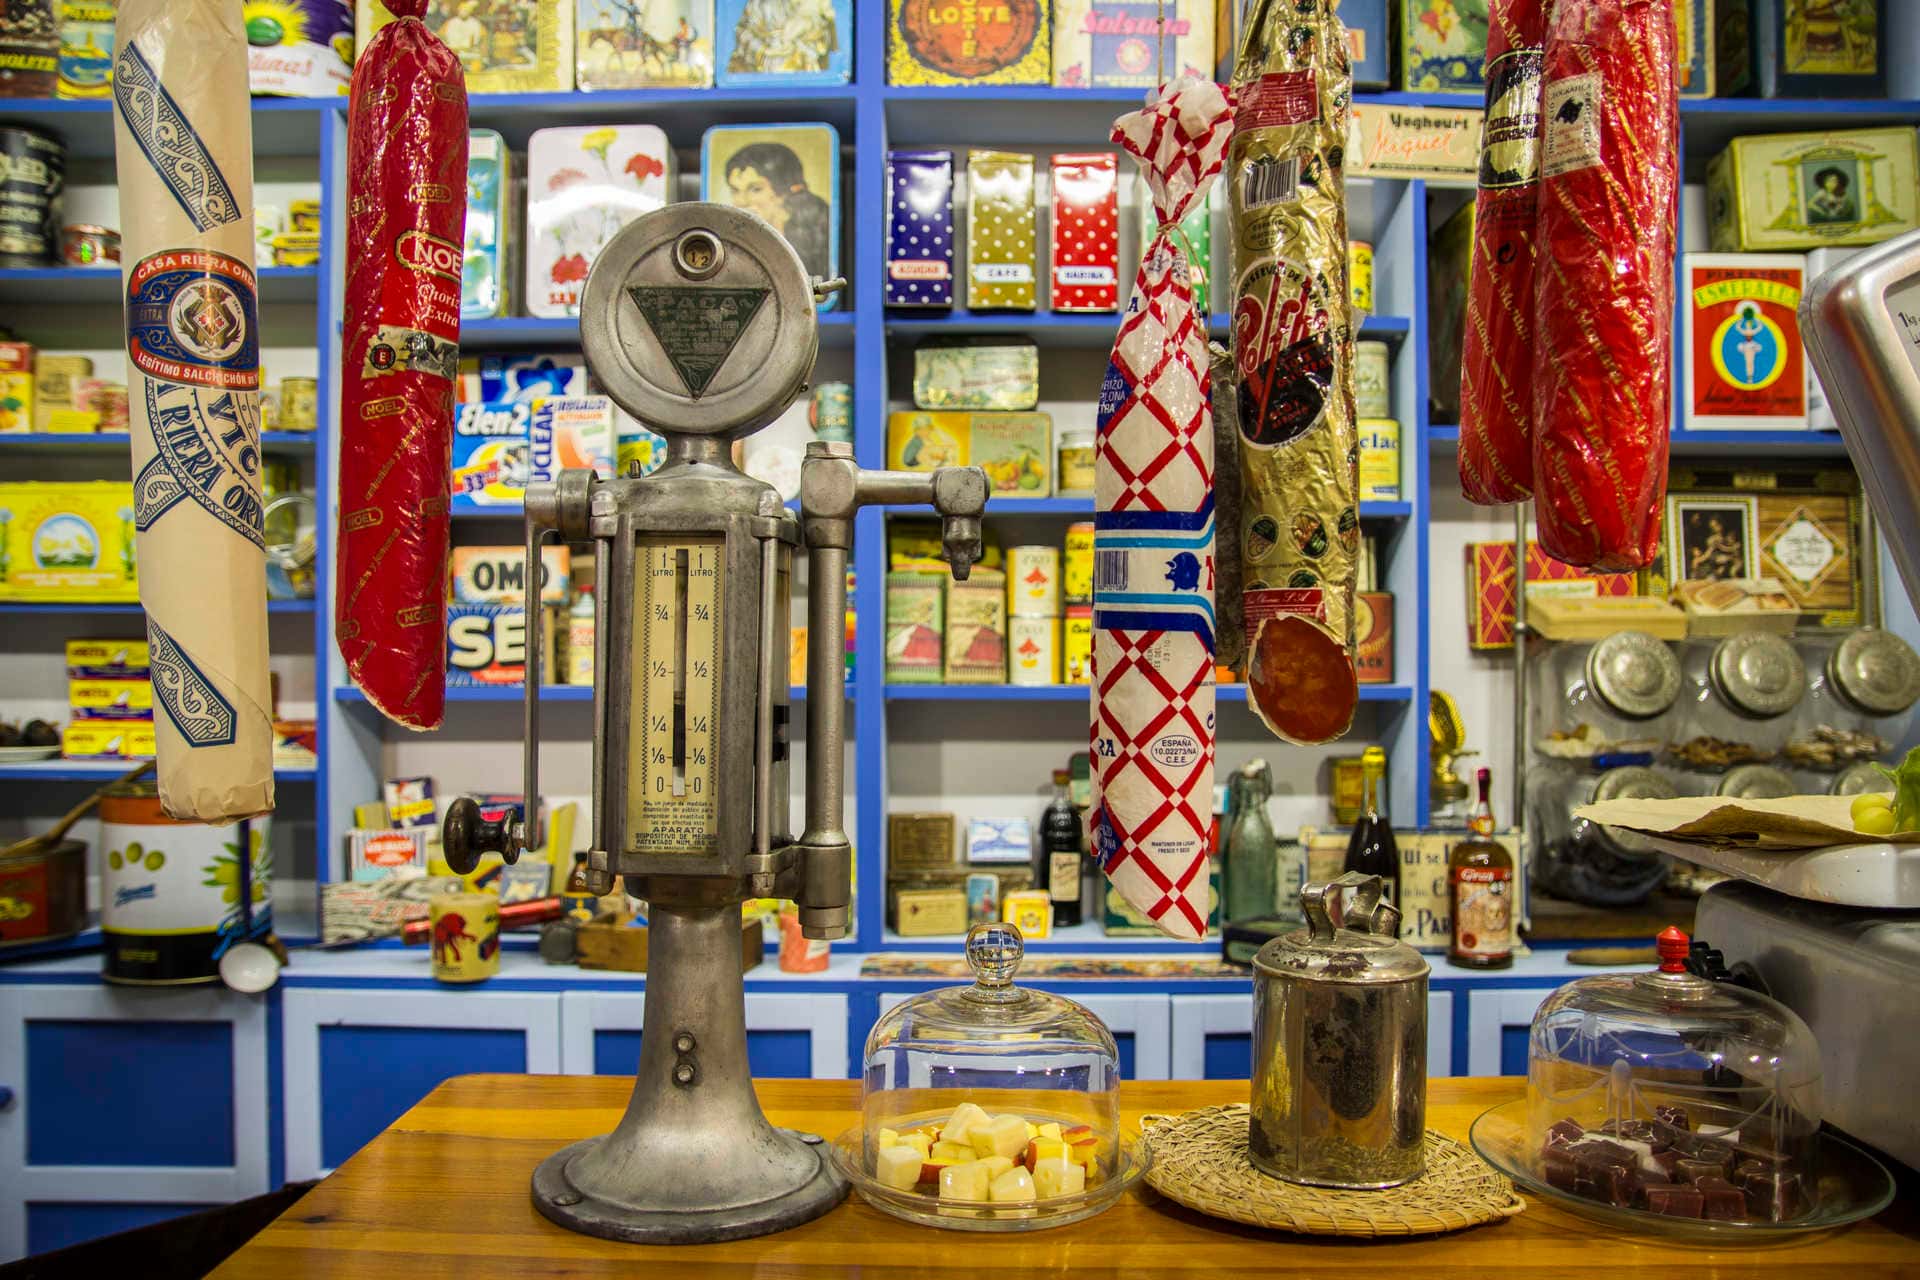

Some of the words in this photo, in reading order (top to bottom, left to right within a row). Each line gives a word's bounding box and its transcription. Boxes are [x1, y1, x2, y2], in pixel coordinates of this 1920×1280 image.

[138, 255, 177, 280] CASA
[180, 255, 230, 271] RIERA
[425, 304, 460, 328] Extra
[138, 351, 181, 377] LEGÍTIMO
[365, 402, 401, 416] NOEL
[652, 569, 674, 577] LITRO
[690, 569, 713, 577] LITRO
